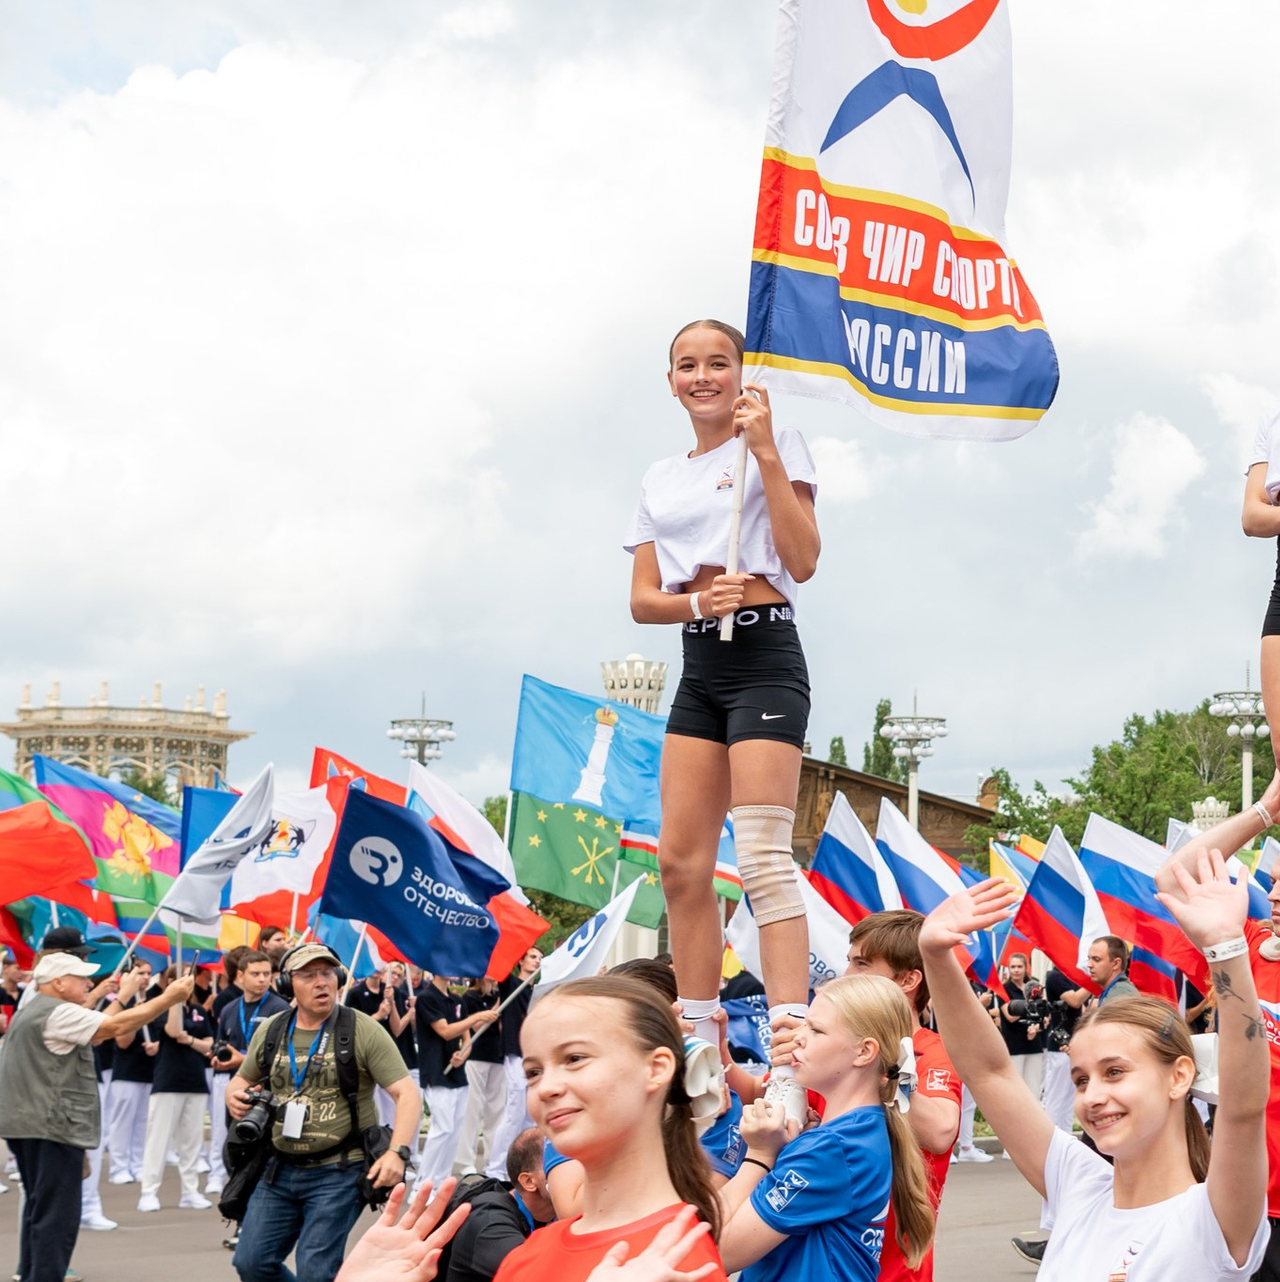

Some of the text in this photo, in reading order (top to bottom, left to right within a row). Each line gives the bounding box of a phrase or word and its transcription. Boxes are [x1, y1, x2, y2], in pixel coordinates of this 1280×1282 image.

[863, 220, 926, 288] ЧИР
[701, 610, 760, 633] PO
[403, 886, 490, 929] ОТЕЧЕСТВО
[317, 1031, 330, 1055] SONY
[319, 1101, 337, 1123] 22
